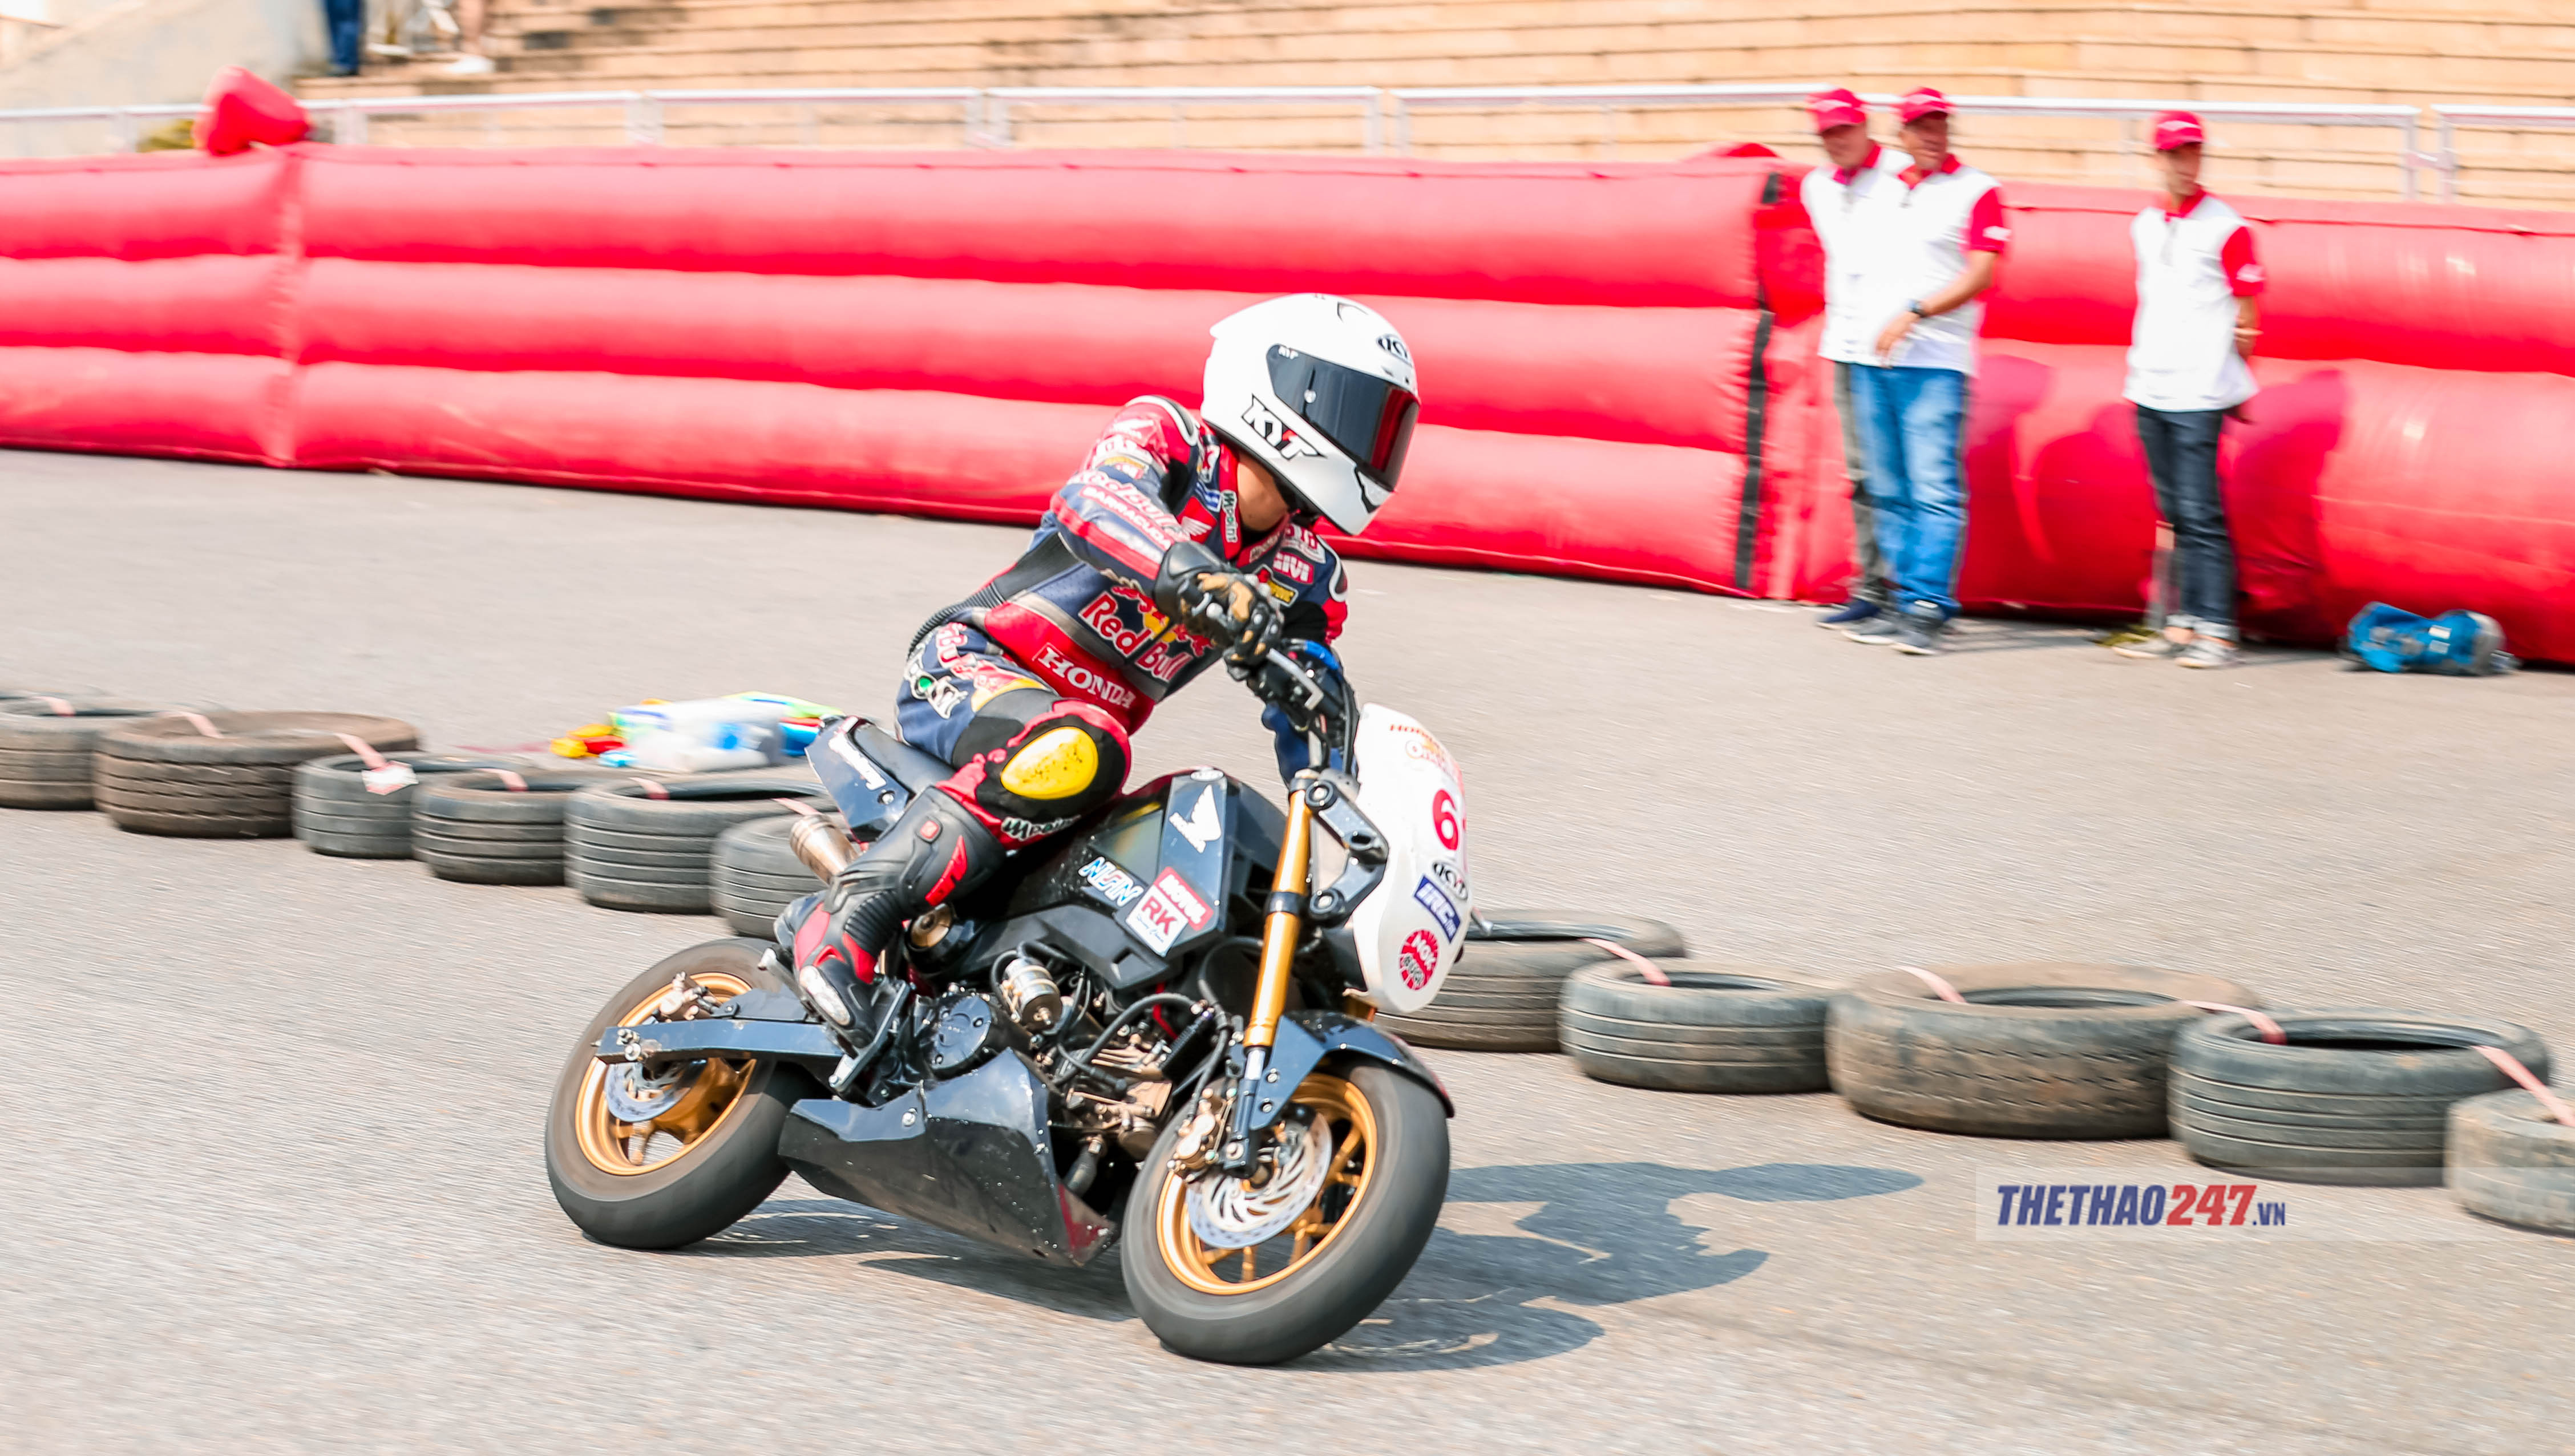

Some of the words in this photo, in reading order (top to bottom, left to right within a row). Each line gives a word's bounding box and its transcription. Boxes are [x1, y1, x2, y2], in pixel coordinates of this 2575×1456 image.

[1240, 394, 1327, 460] KYT
[1078, 591, 1152, 657] Red
[1133, 641, 1193, 682] Bull
[1038, 646, 1138, 709] HONDA
[1432, 788, 1460, 850] 6
[1141, 896, 1179, 936] RK
